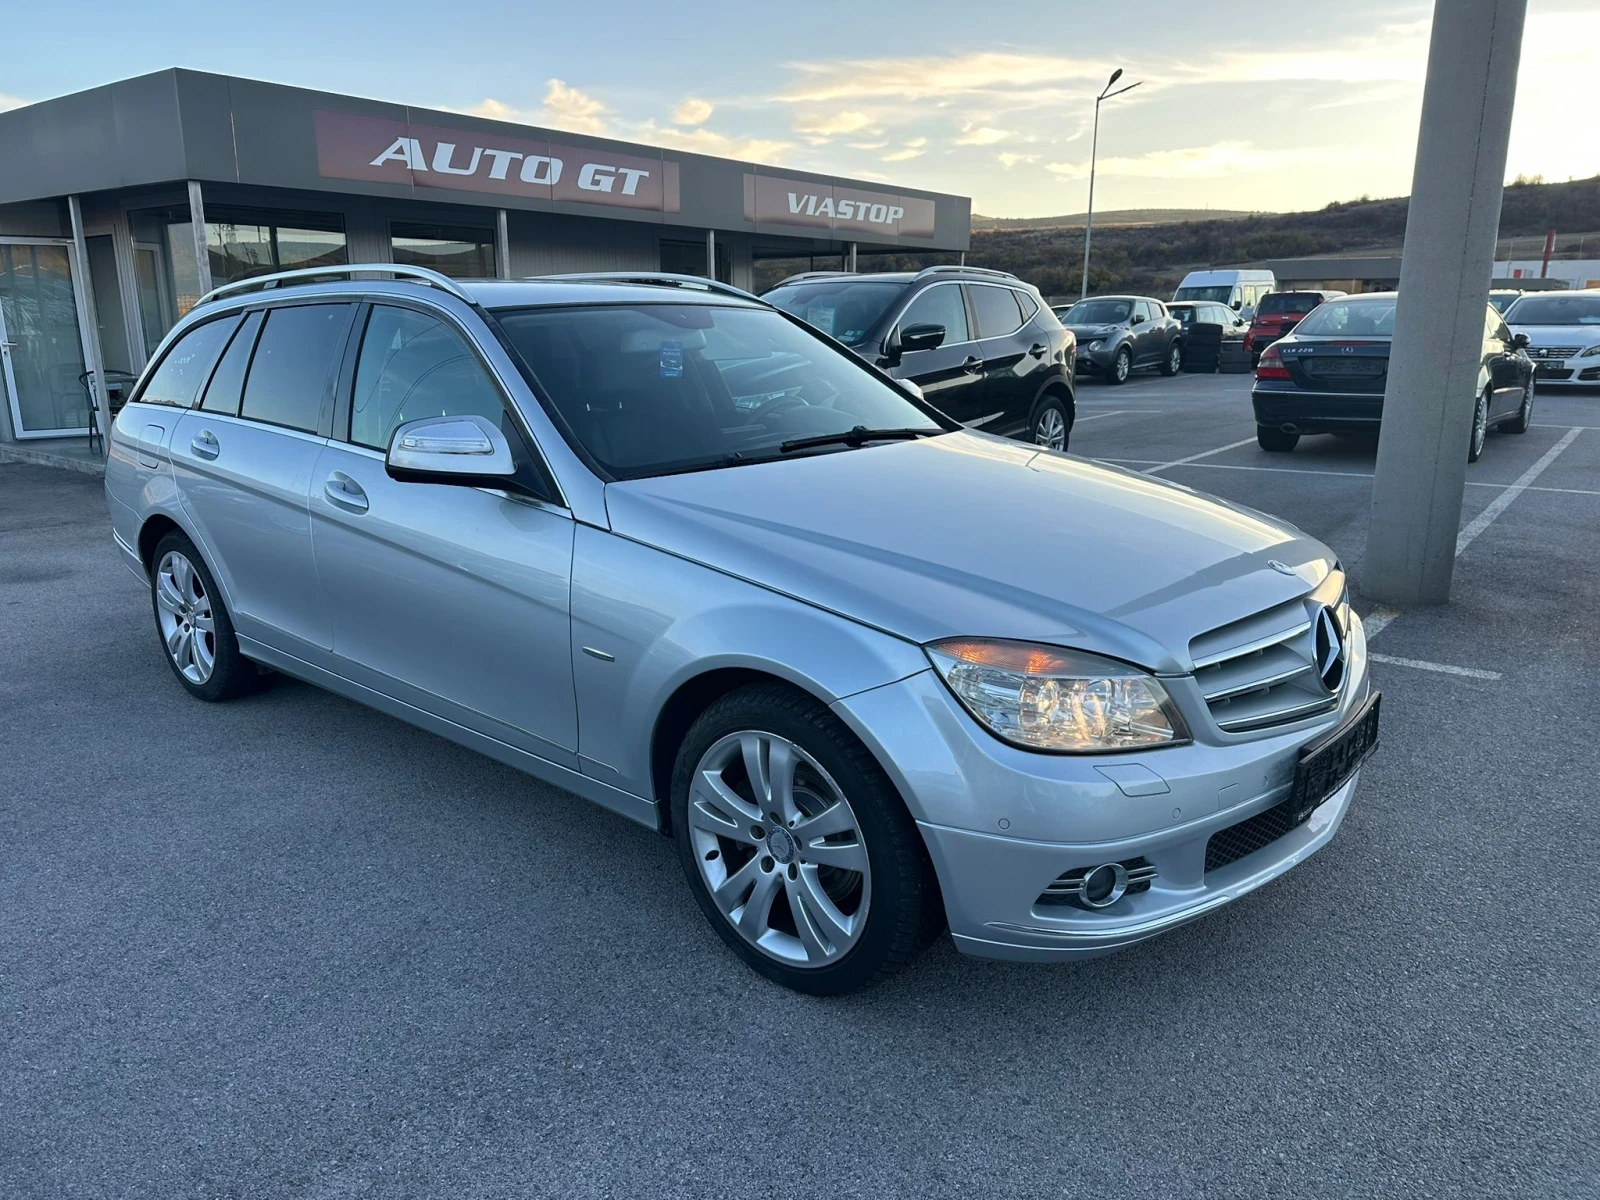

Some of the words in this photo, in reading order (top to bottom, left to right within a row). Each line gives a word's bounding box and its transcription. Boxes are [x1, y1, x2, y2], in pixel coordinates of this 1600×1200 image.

[369, 136, 564, 186] AUTO
[577, 162, 650, 196] GT
[787, 192, 904, 225] VIASTOP
